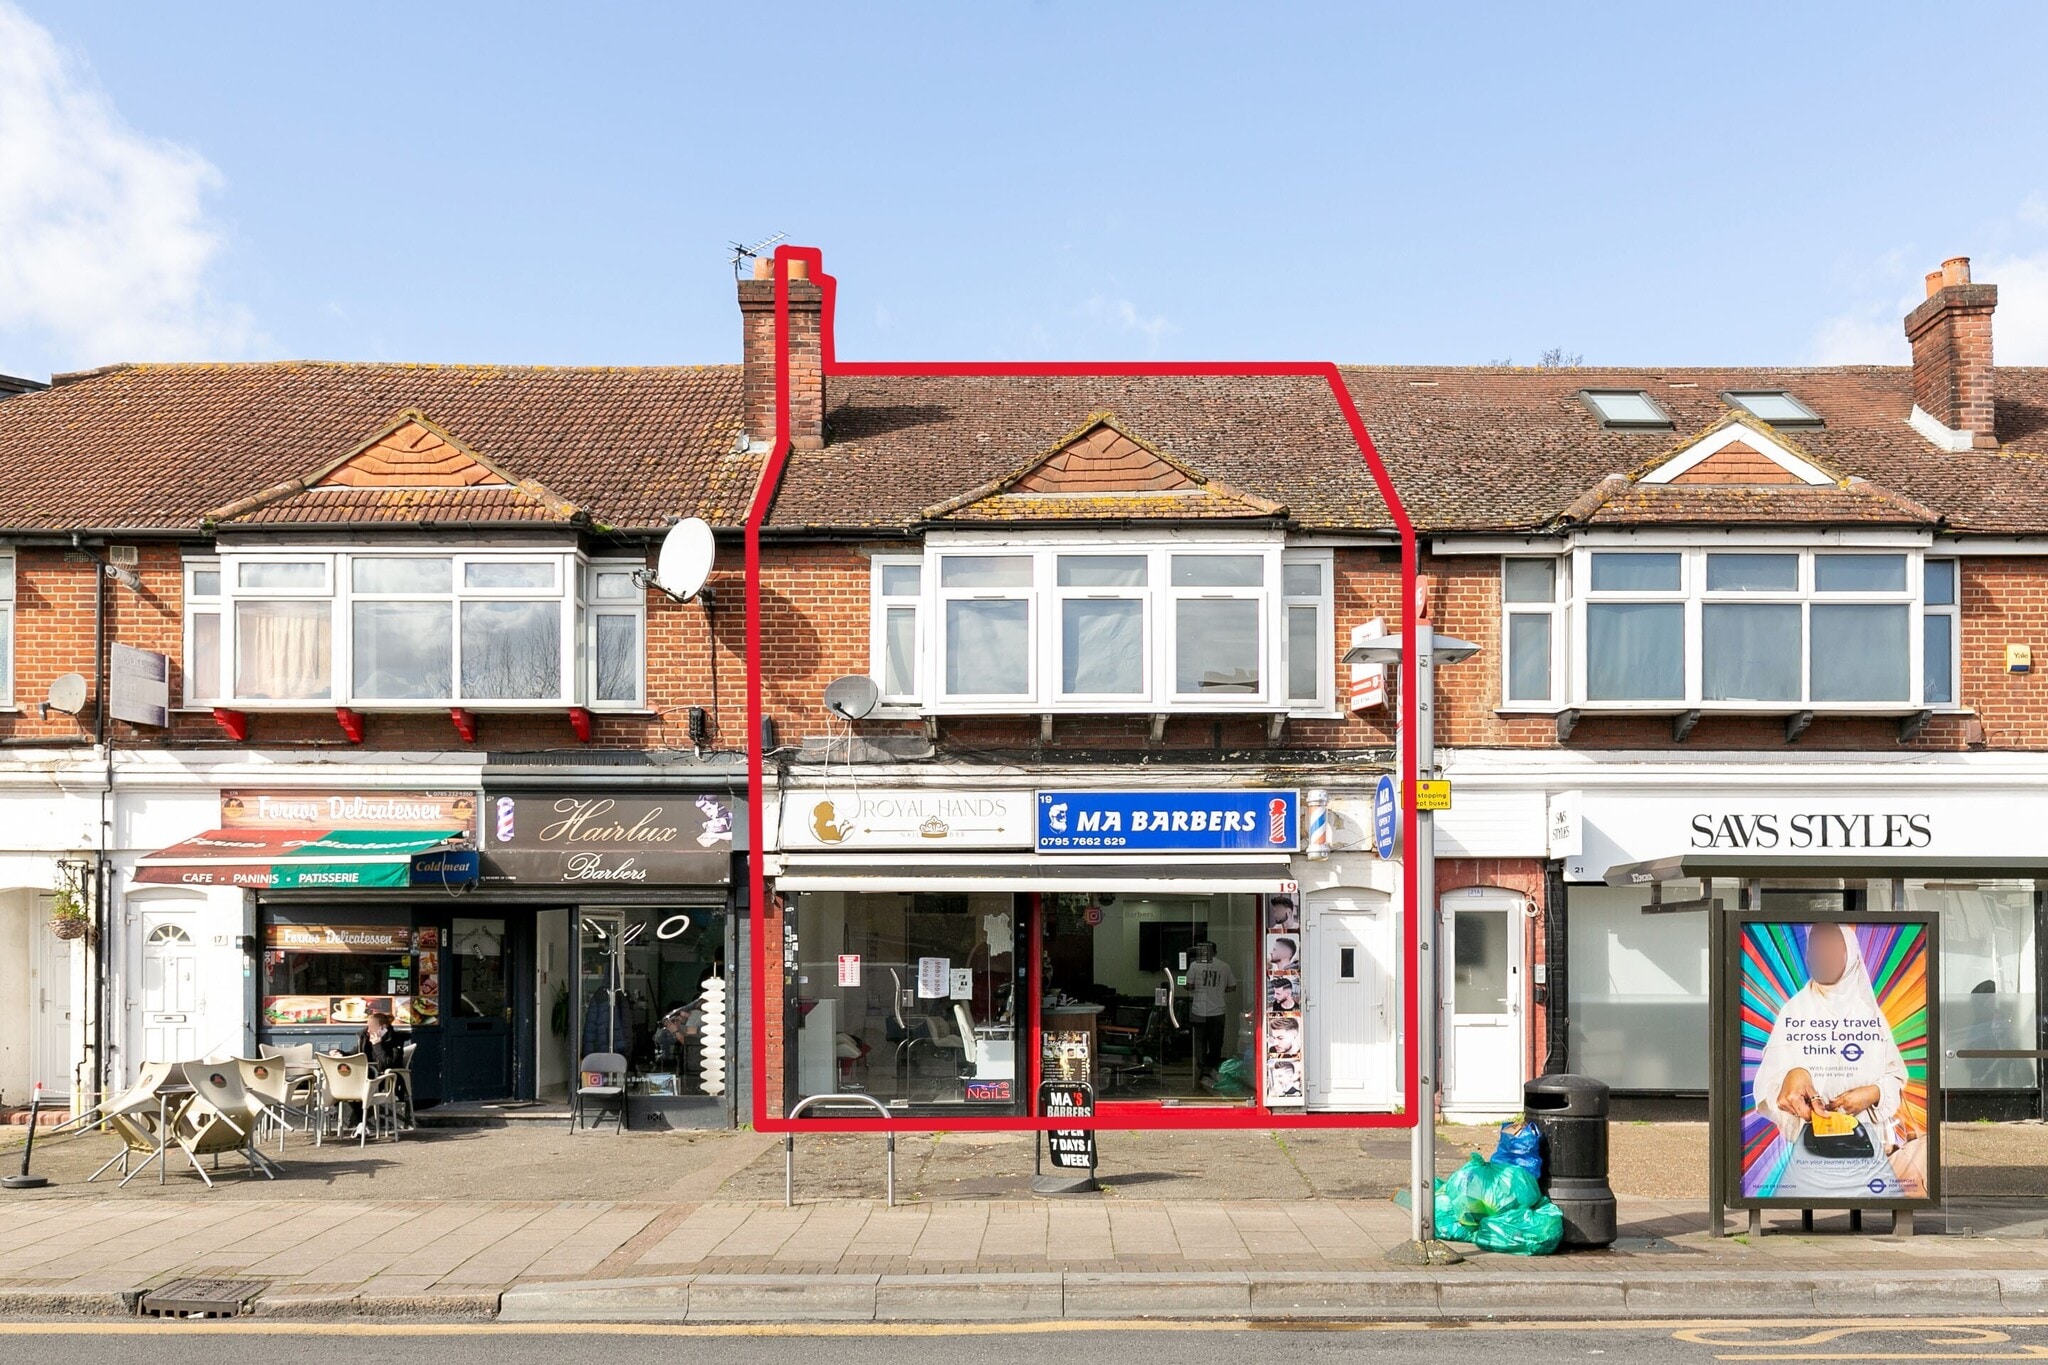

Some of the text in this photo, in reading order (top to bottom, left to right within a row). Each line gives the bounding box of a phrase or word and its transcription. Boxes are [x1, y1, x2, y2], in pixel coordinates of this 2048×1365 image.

[2013, 651, 2029, 659] Yale
[1039, 795, 1053, 804] 19
[257, 796, 442, 821] Fornos Delicatessen
[863, 798, 1008, 818] ROYAL HANDS
[538, 798, 678, 843] Hairlux
[1076, 810, 1257, 832] MA BARBERS
[1555, 811, 1567, 825] SAVS
[1552, 825, 1570, 841] STYLES
[1691, 813, 1932, 849] SAVS STYLES
[1040, 837, 1127, 846] 0795 7662 629
[415, 861, 471, 873] Cold meat
[563, 852, 647, 881] Barbers
[1574, 866, 1584, 874] 21
[182, 873, 360, 884] CAFE PANINIS PATISSERIE
[1279, 882, 1297, 893] 19
[213, 936, 223, 944] 17
[283, 928, 320, 945] Fornos
[325, 927, 393, 945] Delicatessen
[1785, 1017, 1882, 1030] For easy travel
[1786, 1031, 1884, 1043] across London,
[1803, 1044, 1837, 1055] think
[1046, 1106, 1091, 1117] BARBERS
[1050, 1139, 1058, 1151] 7
[1058, 1139, 1086, 1152] DAYS
[1060, 1153, 1091, 1167] WEEK
